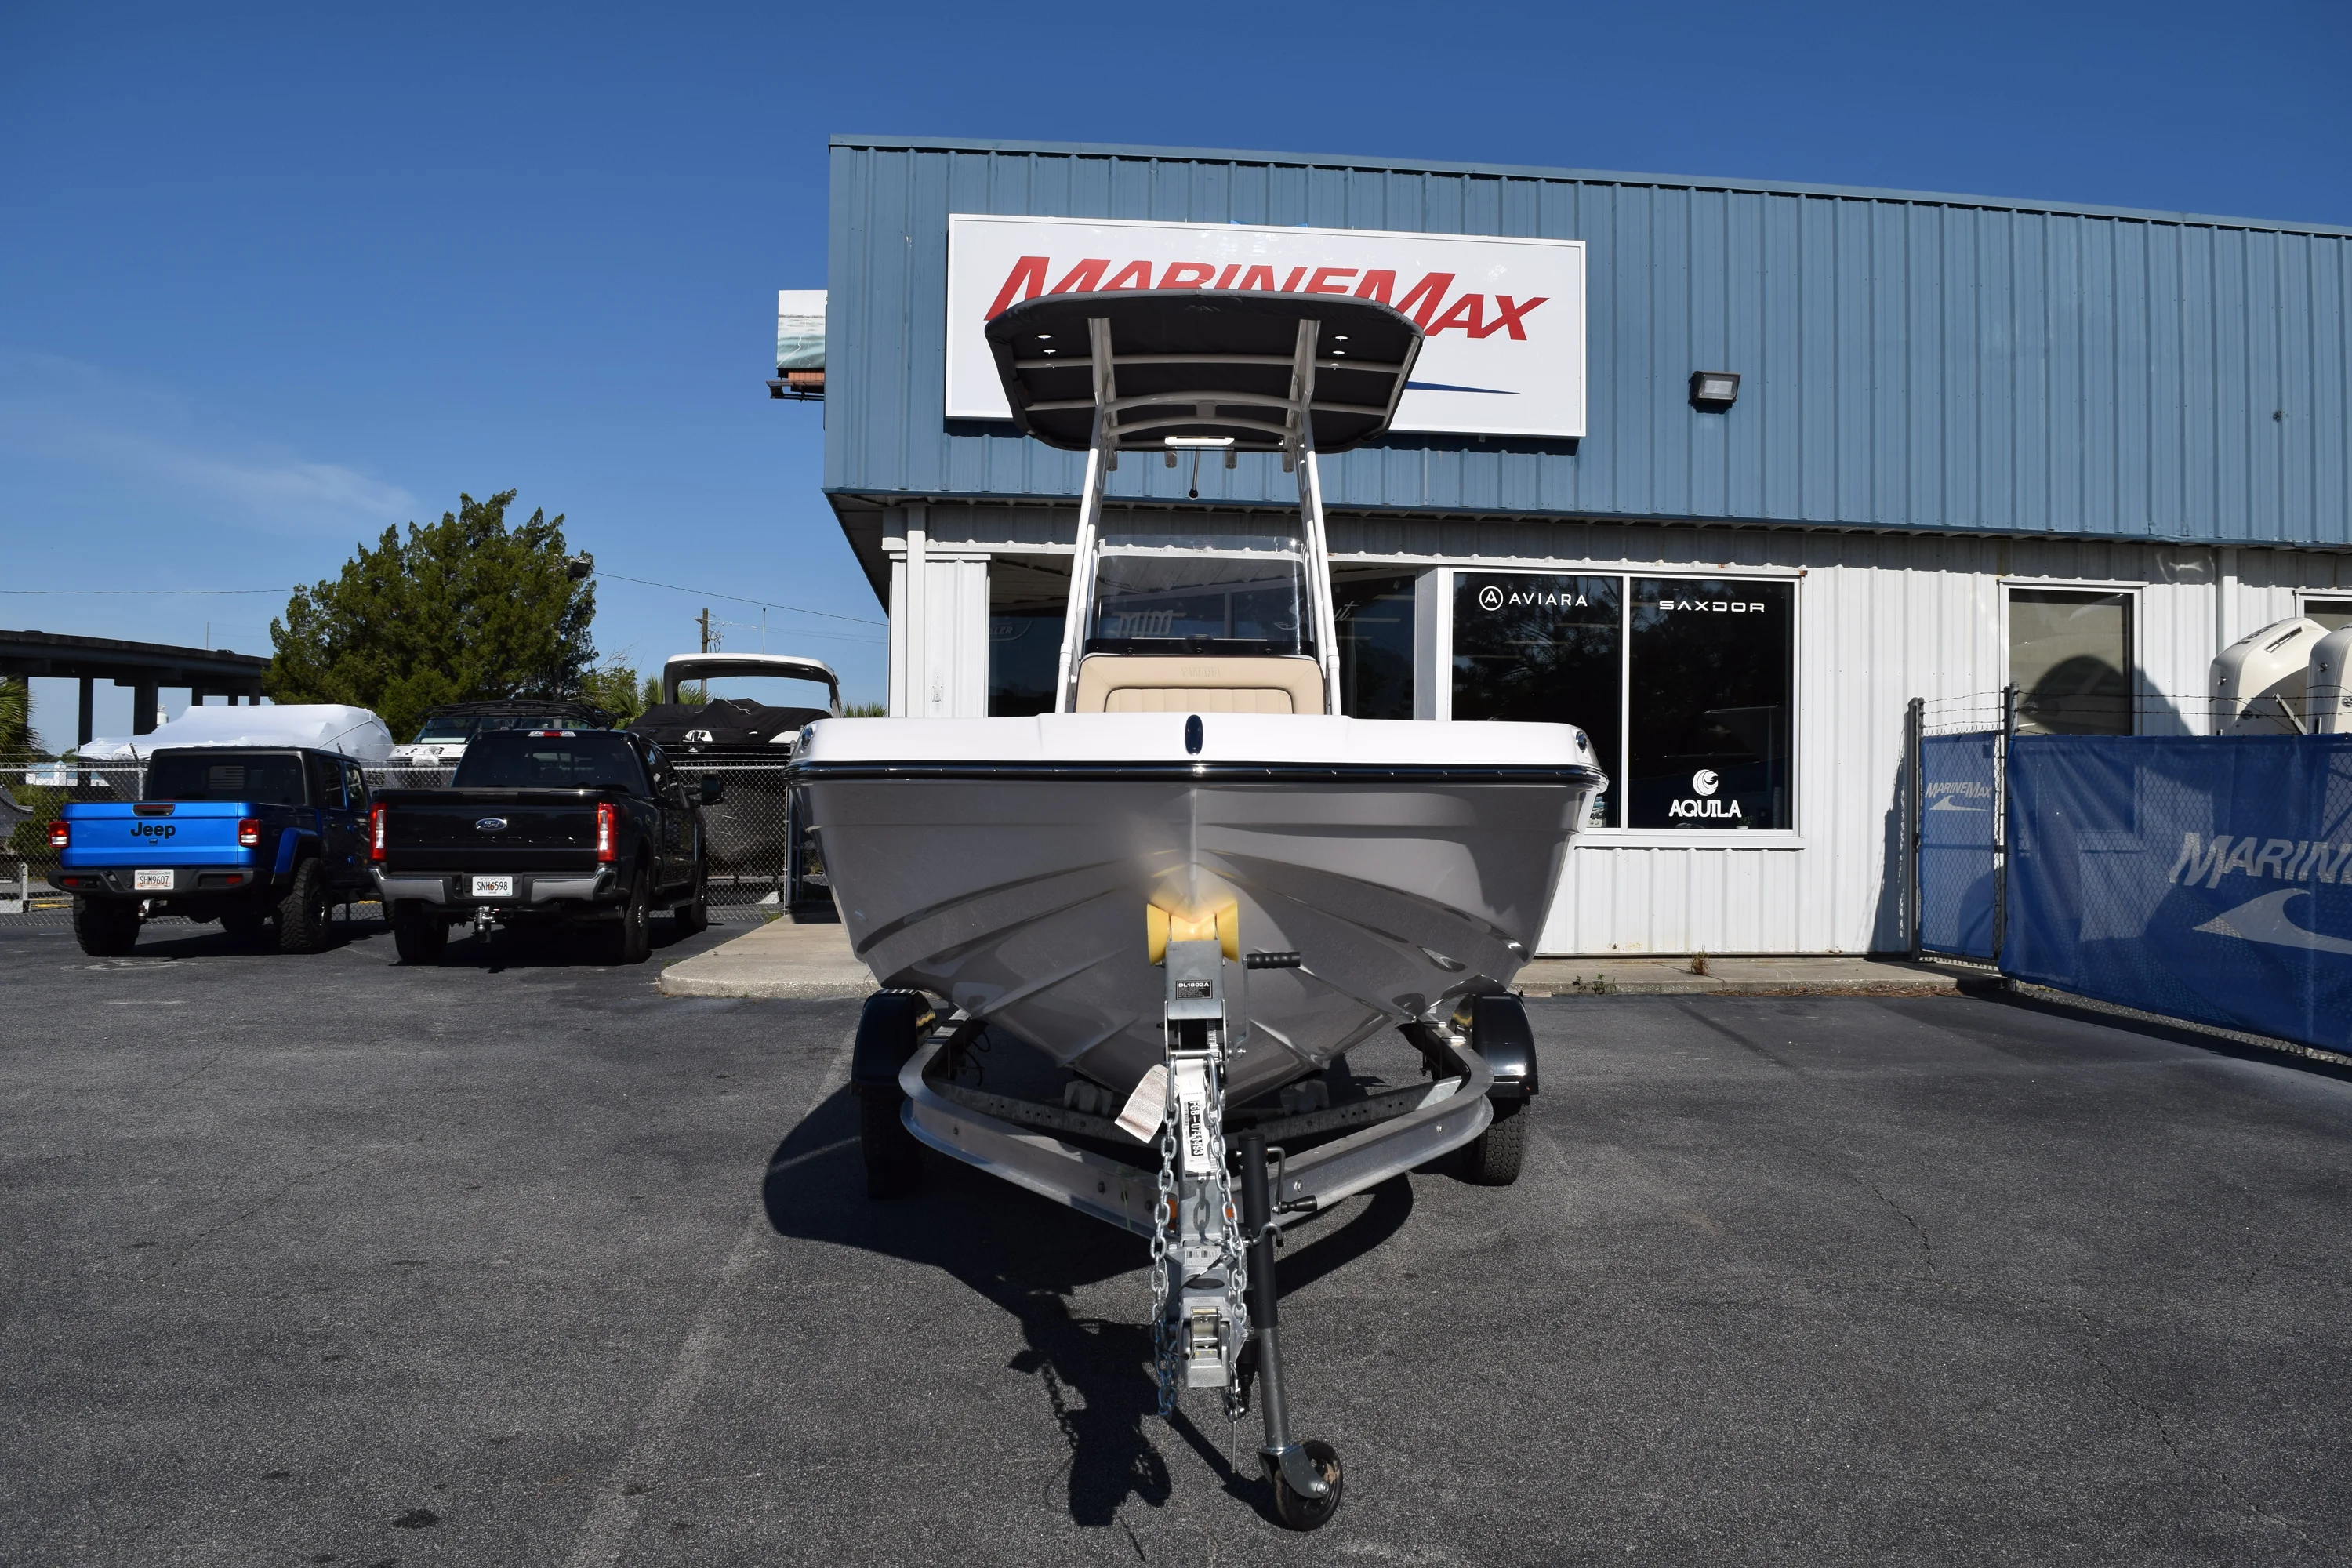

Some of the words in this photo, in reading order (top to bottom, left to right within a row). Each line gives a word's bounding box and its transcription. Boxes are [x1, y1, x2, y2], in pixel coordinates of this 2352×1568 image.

[1508, 592, 1588, 607] AVIARA
[1659, 600, 1766, 613] SAXDOR
[1179, 666, 1221, 678] YAMAHA
[1924, 782, 1993, 799] MARINEMAX
[1668, 799, 1742, 818] AQUILA
[130, 821, 176, 840] Jeep
[2169, 832, 2352, 890] MARIN
[139, 875, 169, 885] SHM9607
[477, 881, 509, 891] SNH6598
